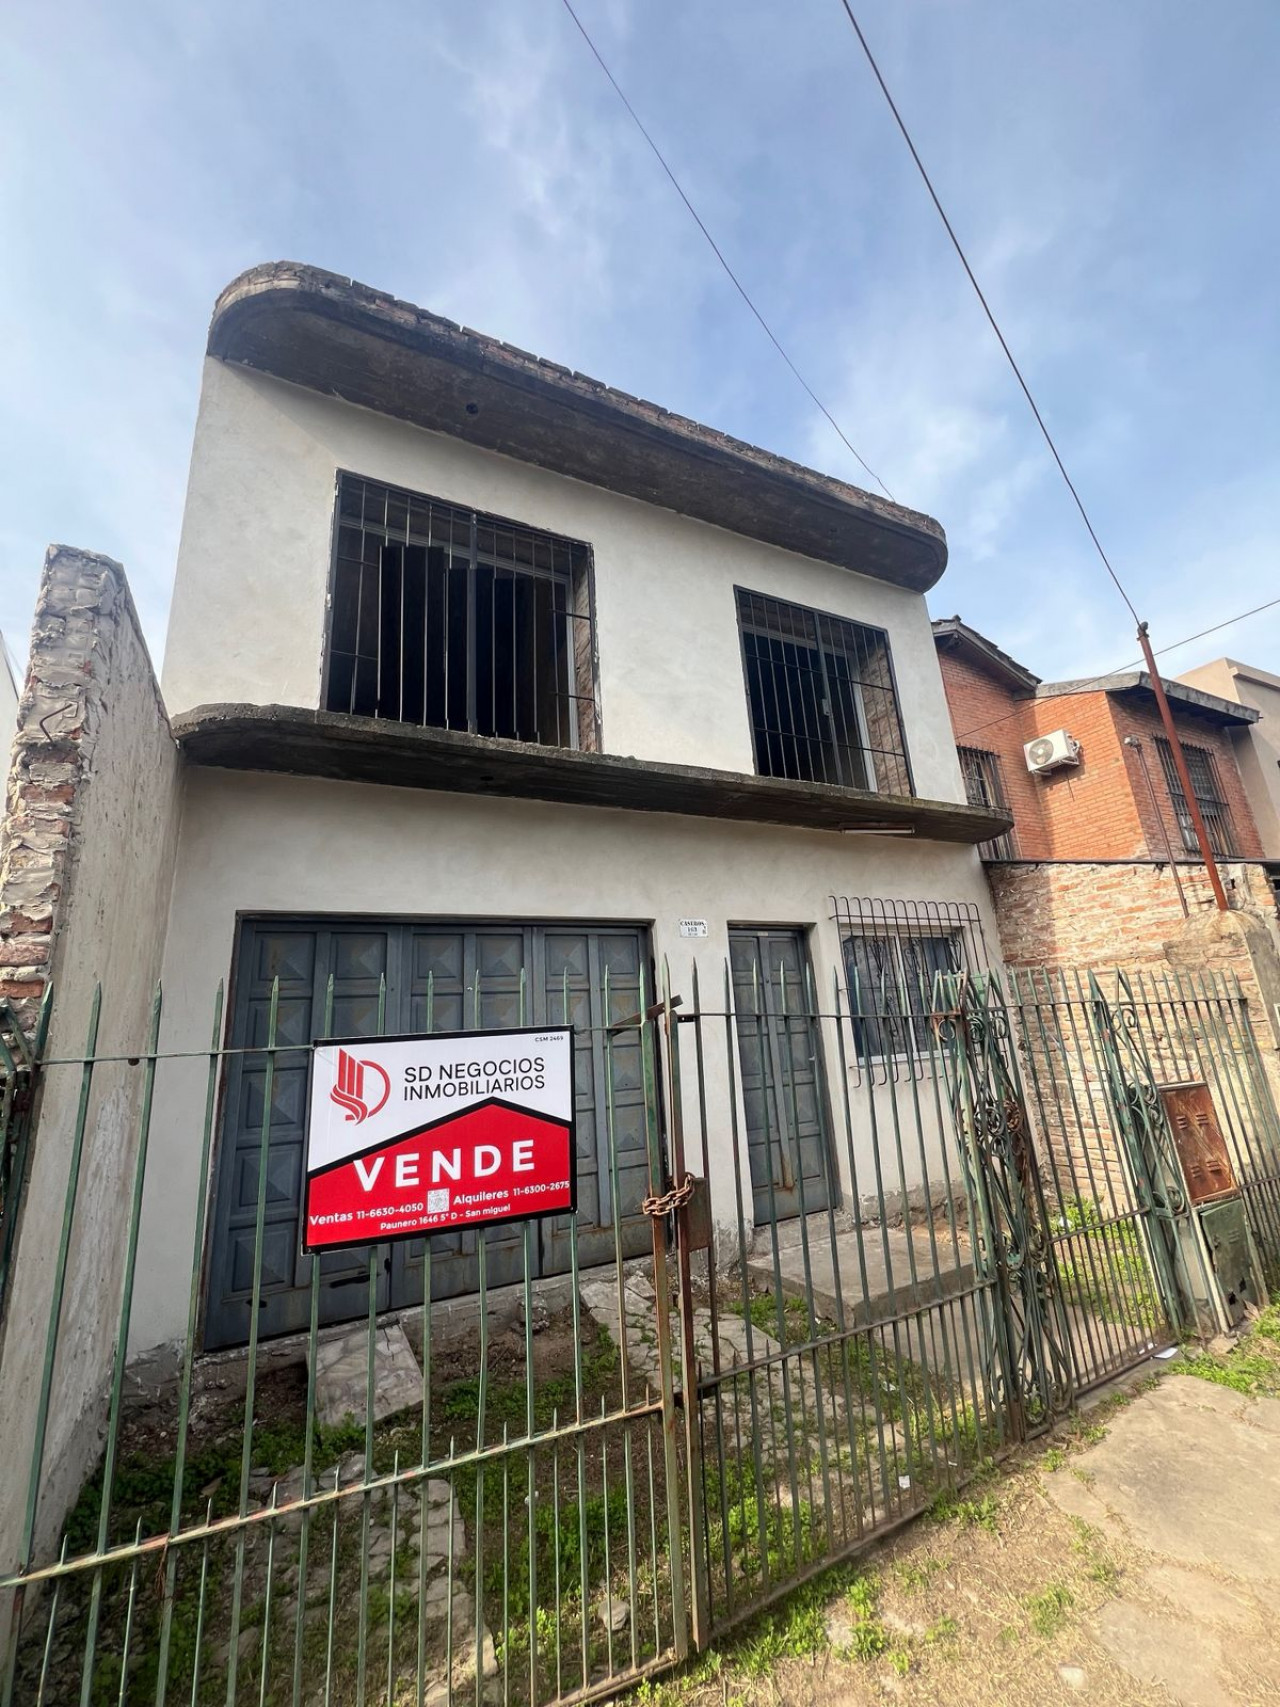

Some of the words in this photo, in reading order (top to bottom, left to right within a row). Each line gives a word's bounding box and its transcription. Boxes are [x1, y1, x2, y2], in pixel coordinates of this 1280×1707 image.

[404, 1066, 432, 1083] SD
[439, 1057, 545, 1080] NEGOCIOS
[404, 1075, 545, 1101] INMOBILIARIOS
[353, 1139, 535, 1192] VENDE
[453, 1190, 509, 1205] Alquileres
[513, 1180, 570, 1196] 11-6300-2675
[309, 1212, 353, 1226] Ventas
[357, 1202, 424, 1219] 11-6630-4050
[380, 1219, 417, 1231] Paunero
[419, 1215, 438, 1225] 1646
[451, 1212, 458, 1220] D
[465, 1209, 481, 1218] San
[482, 1203, 511, 1216] miguel
